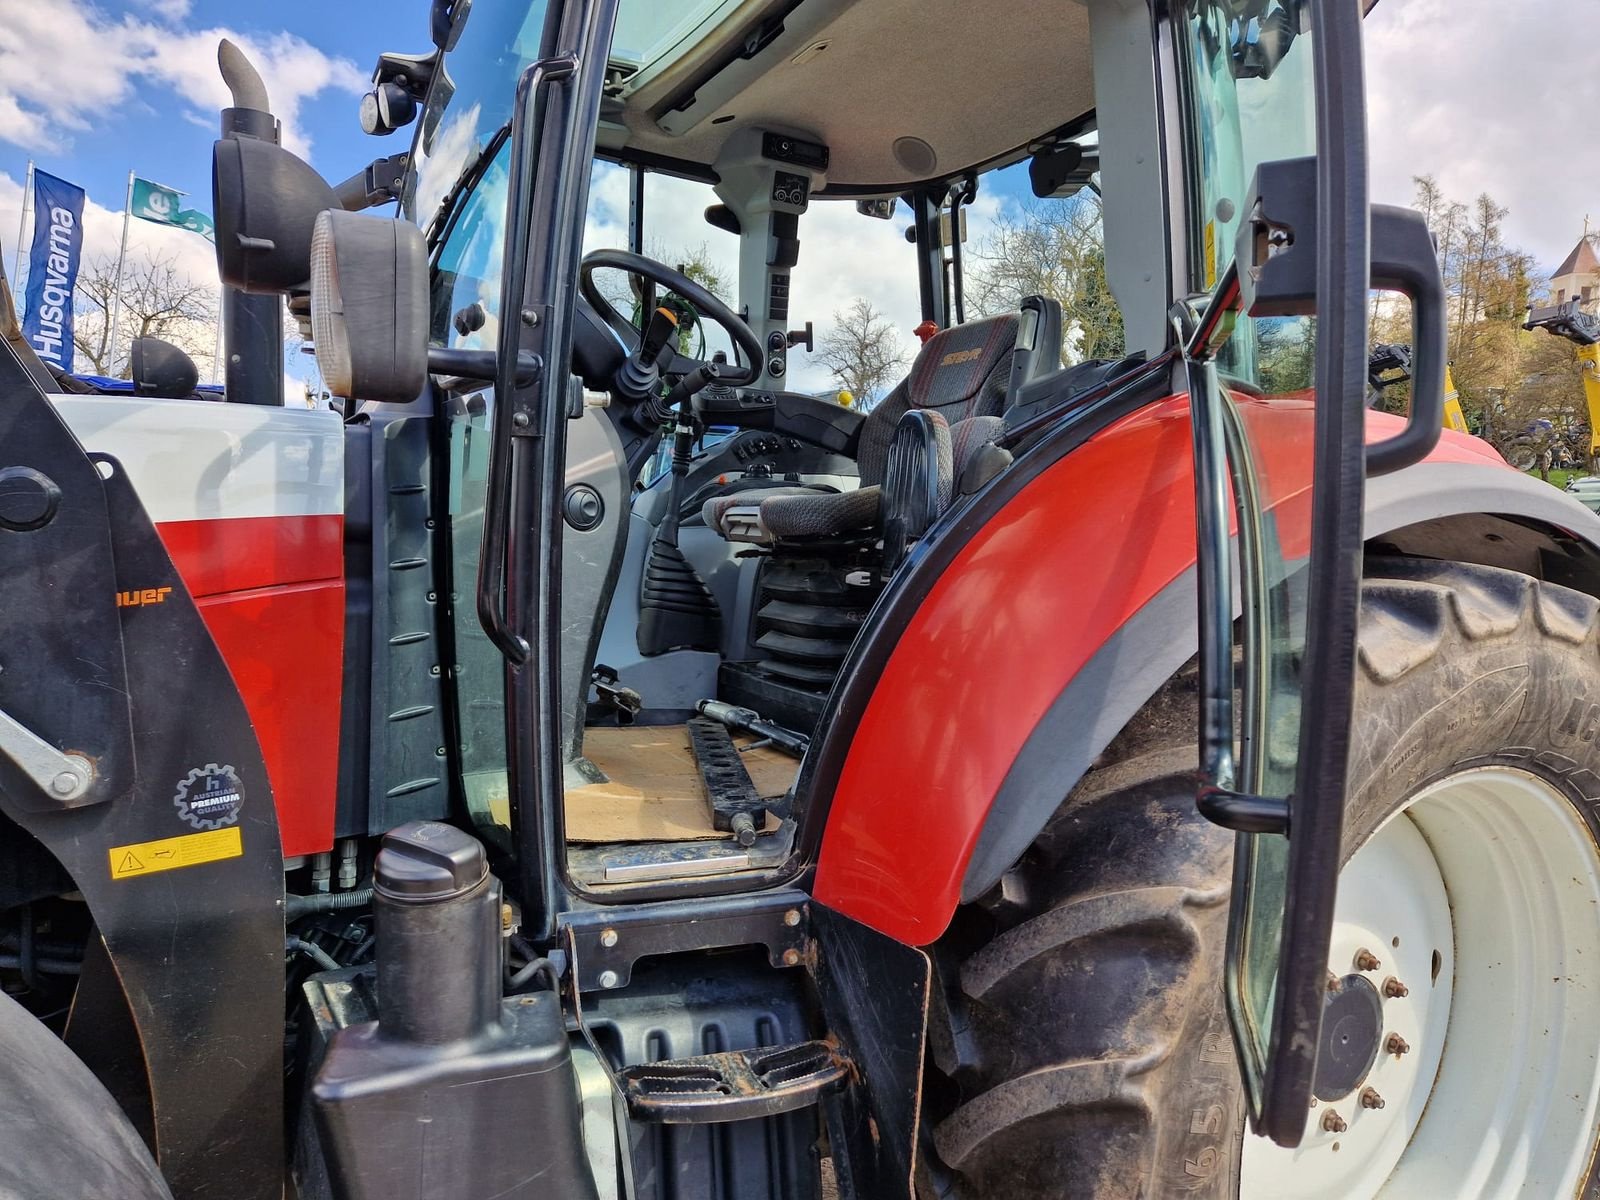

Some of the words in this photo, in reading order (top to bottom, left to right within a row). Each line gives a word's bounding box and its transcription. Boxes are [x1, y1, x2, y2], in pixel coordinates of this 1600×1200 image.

[33, 206, 74, 361] Husqvarna
[116, 587, 172, 607] uer
[190, 793, 240, 809] PREMIUM
[193, 788, 235, 801] AUSTRIAN
[197, 802, 235, 815] QUALITY
